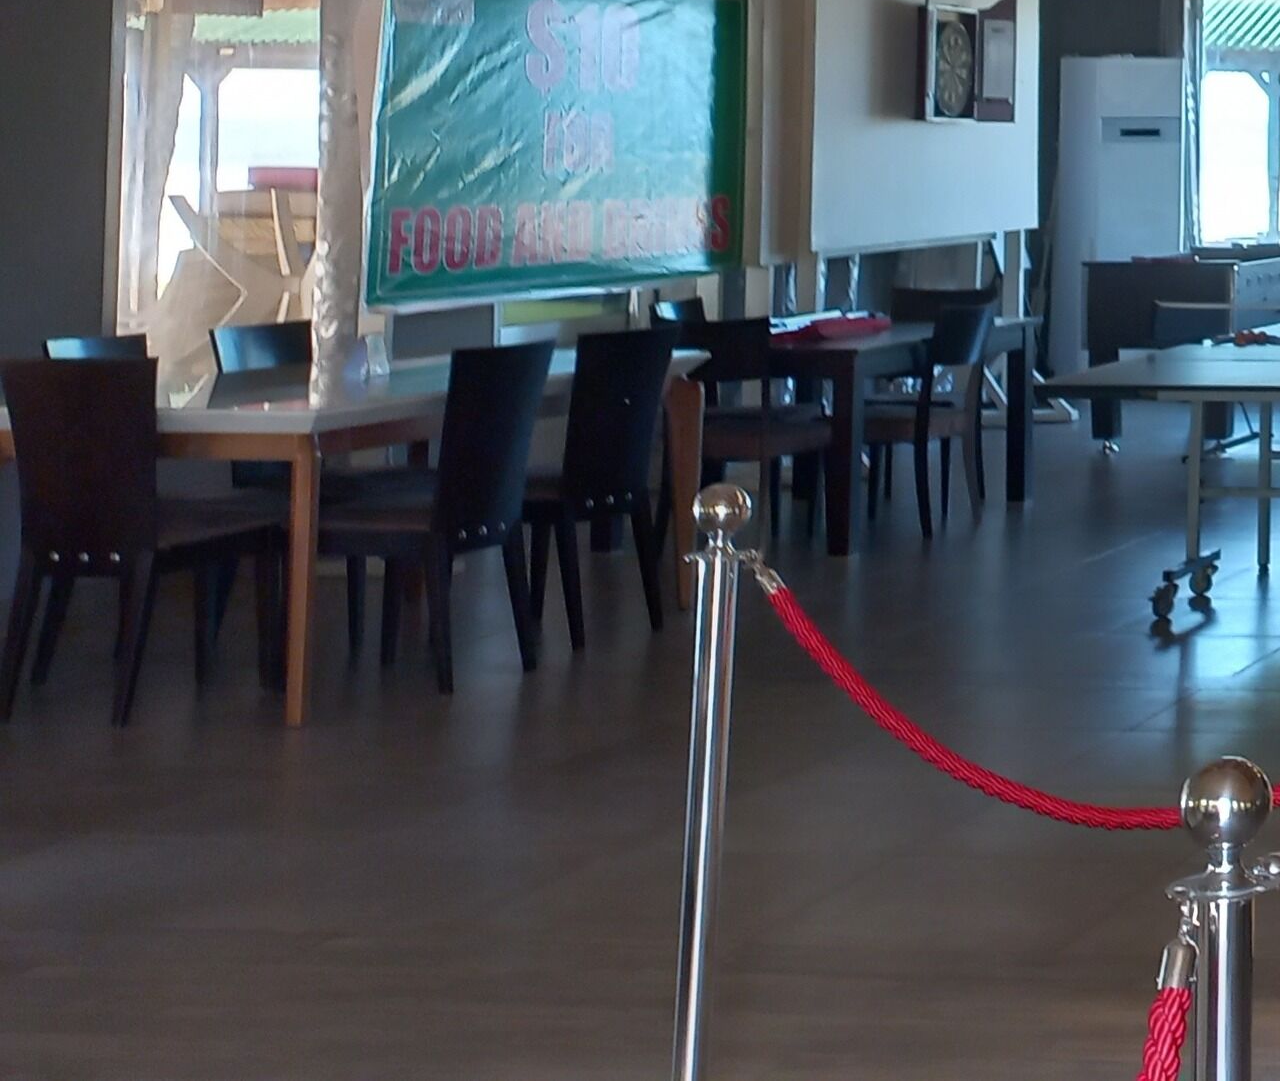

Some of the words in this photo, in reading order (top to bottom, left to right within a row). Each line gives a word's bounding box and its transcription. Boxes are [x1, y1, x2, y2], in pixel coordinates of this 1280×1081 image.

[543, 109, 614, 173] FOR
[386, 204, 503, 275] FOOD
[511, 199, 592, 267] AND
[603, 195, 731, 260] DRINKS
